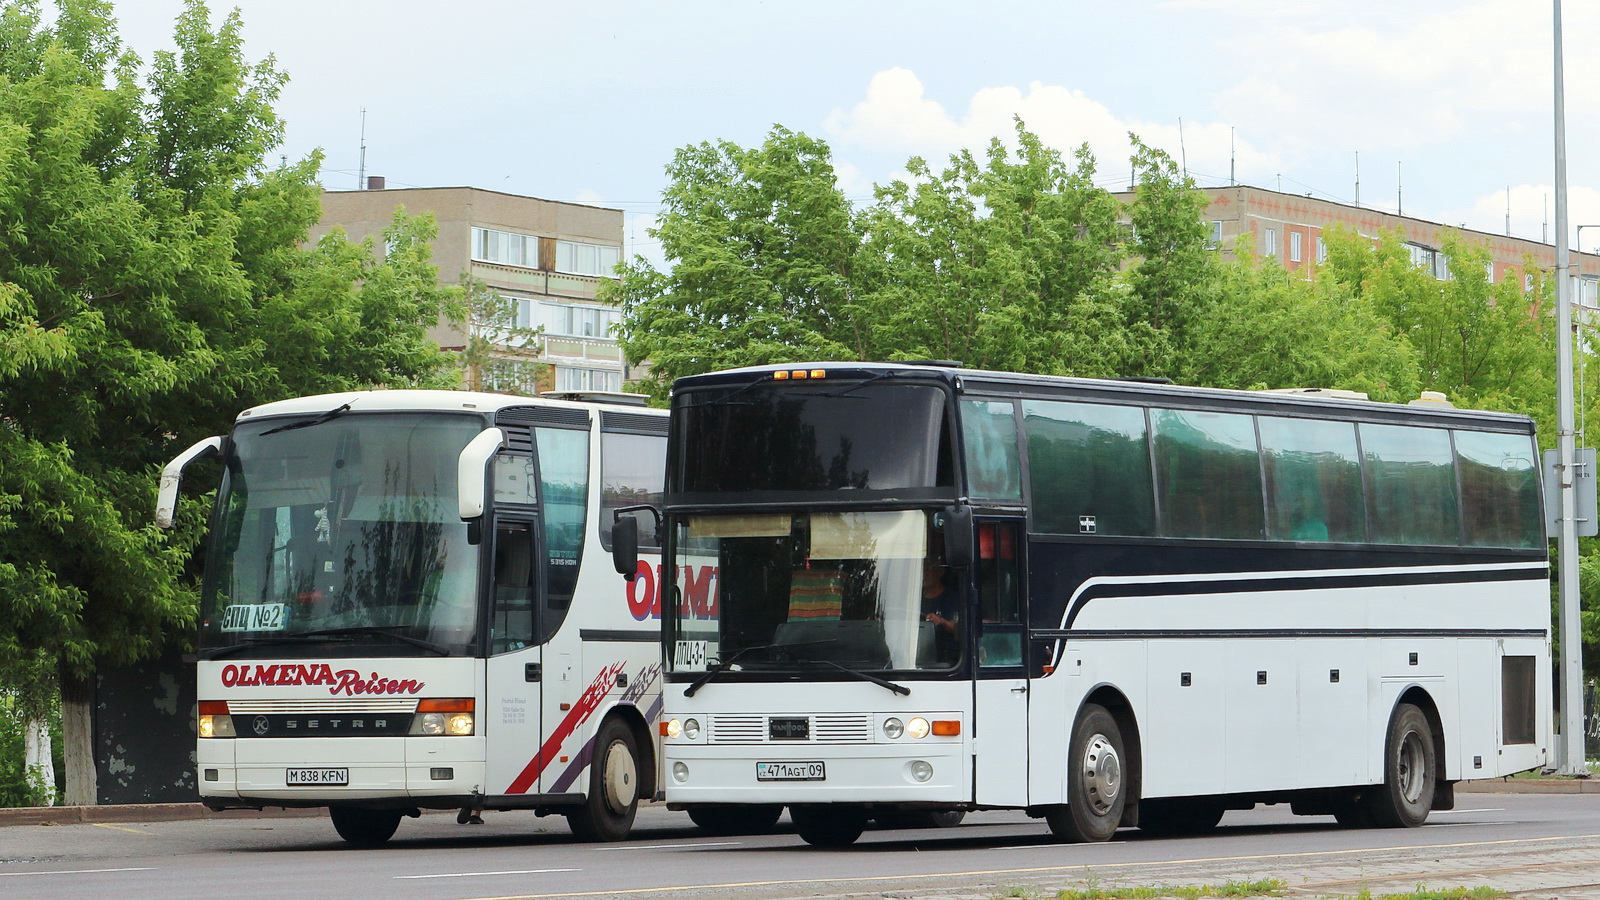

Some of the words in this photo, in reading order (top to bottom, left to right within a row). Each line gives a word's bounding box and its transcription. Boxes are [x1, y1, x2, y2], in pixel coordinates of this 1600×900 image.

[626, 559, 719, 621] OM
[222, 606, 250, 631] СПЦ
[221, 663, 337, 688] OLMENA
[329, 668, 426, 697] Reisen
[286, 719, 388, 729] SETRA
[290, 770, 298, 782] M
[300, 770, 319, 782] 838
[321, 770, 344, 782] KFN
[808, 764, 822, 777] 09
